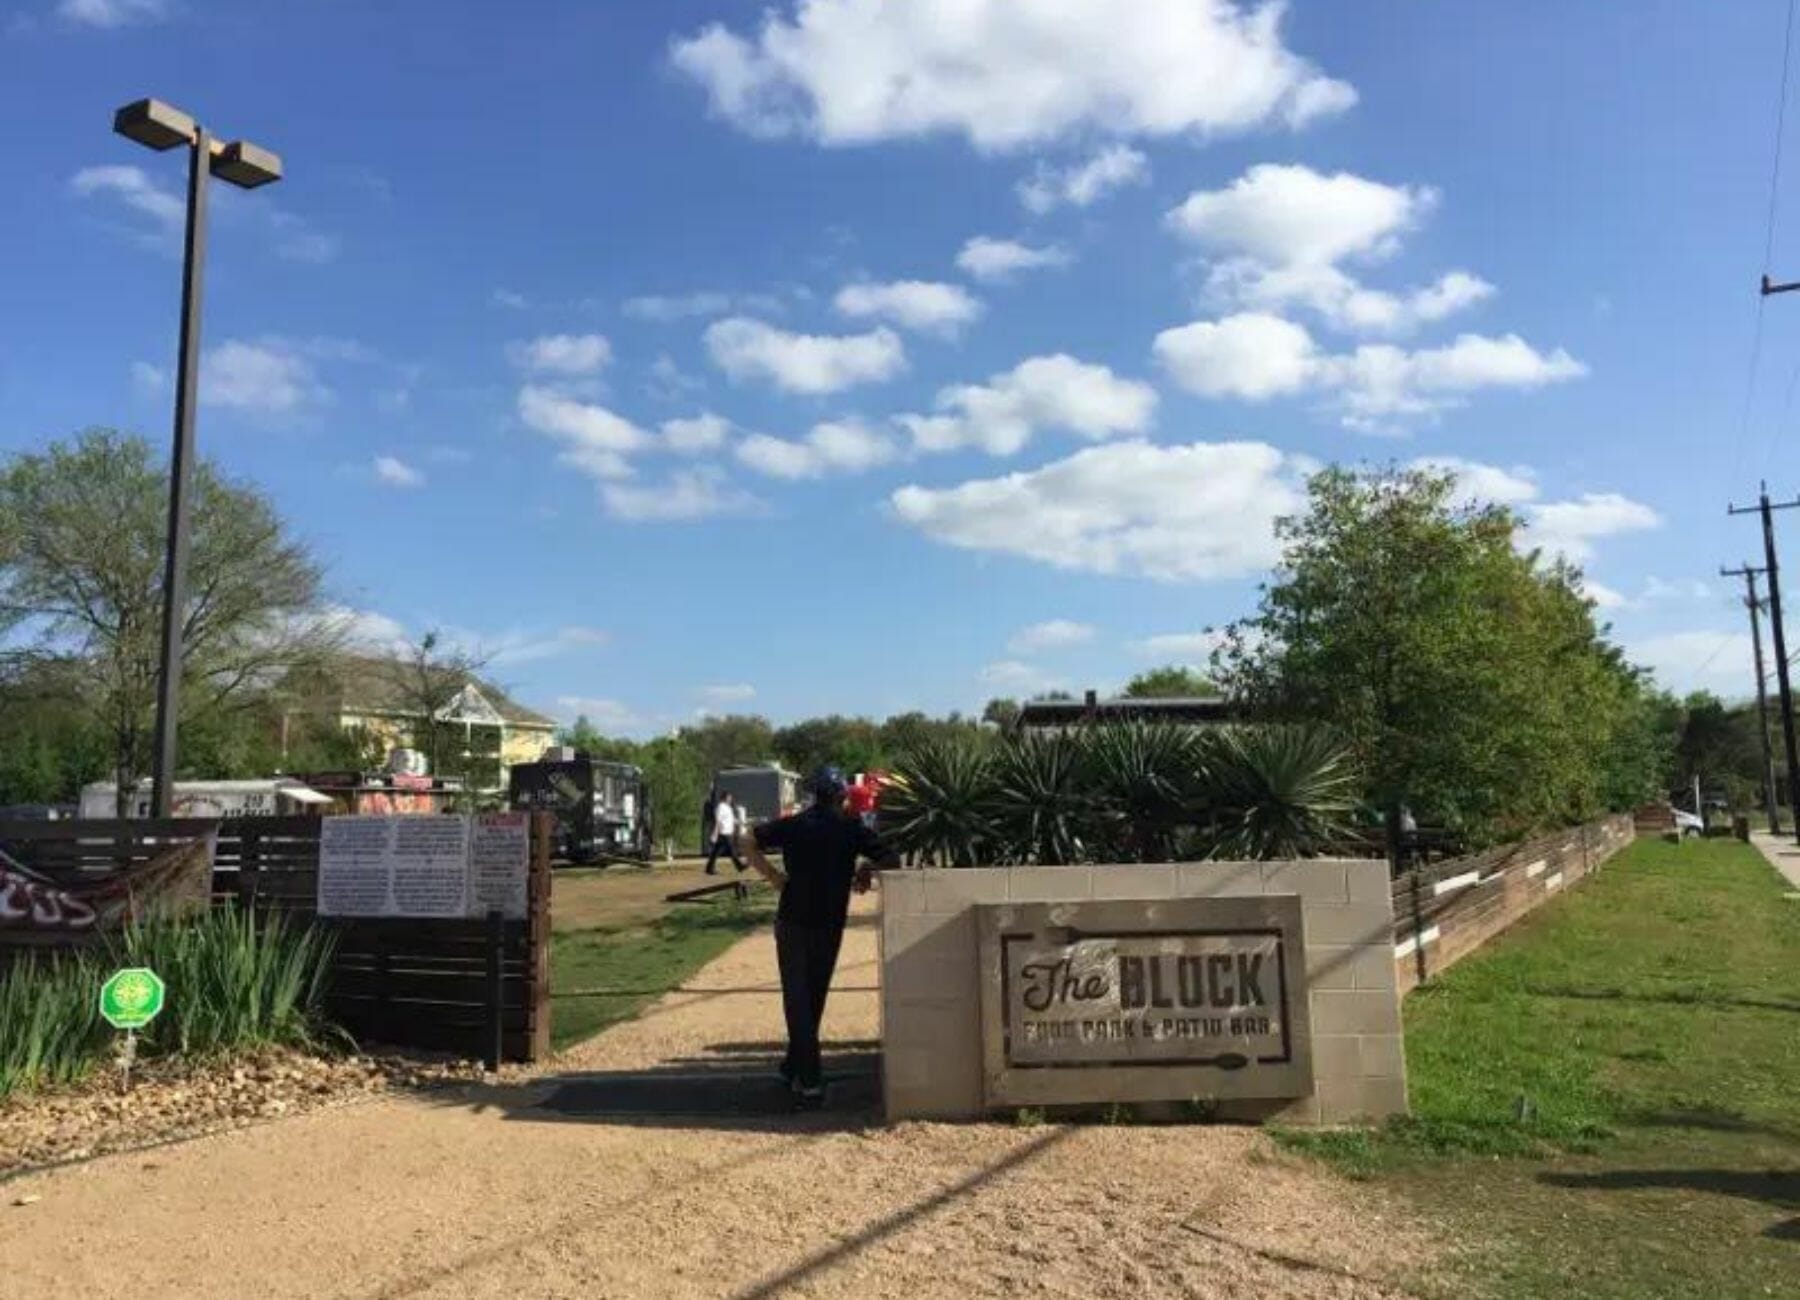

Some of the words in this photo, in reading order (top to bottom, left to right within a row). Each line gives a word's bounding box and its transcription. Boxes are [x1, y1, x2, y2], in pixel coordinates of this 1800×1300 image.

[1021, 957, 1111, 1012] The
[1119, 952, 1266, 1010] BLOCK
[1082, 1019, 1134, 1039] PARK
[1161, 1017, 1223, 1038] PATIO
[1230, 1016, 1270, 1036] BAR
